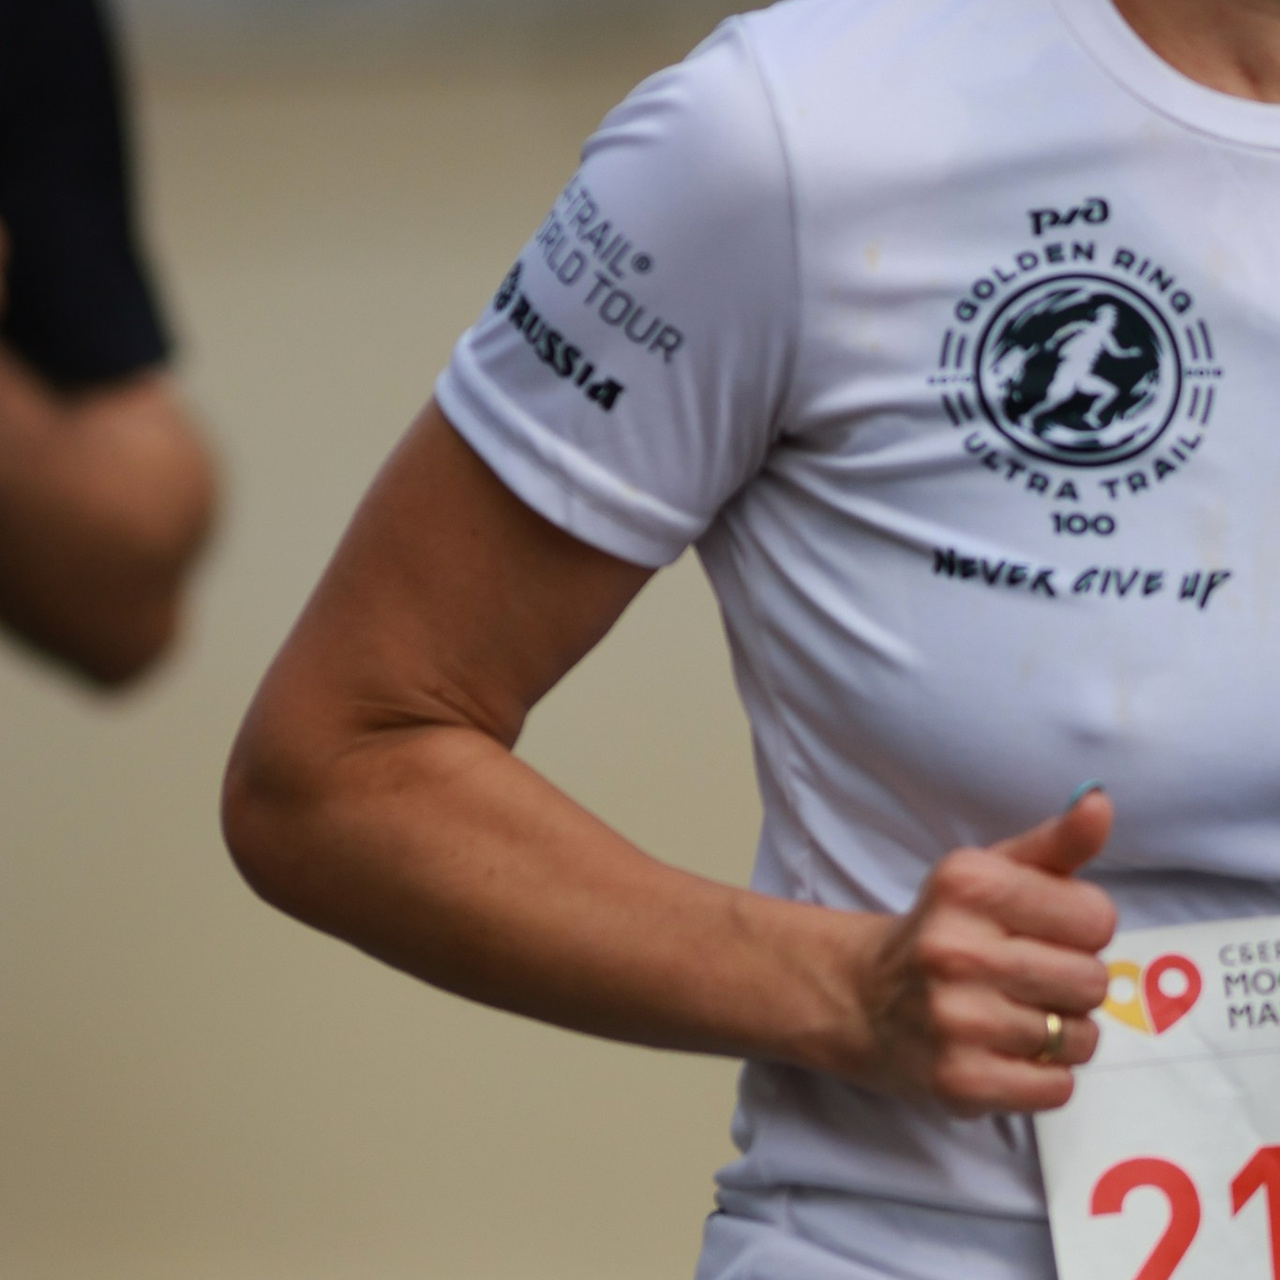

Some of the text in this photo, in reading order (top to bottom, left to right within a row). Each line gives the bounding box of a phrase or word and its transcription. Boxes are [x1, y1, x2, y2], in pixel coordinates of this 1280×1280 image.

[584, 270, 684, 363] TOUR
[955, 242, 1193, 321] GOLDEN RING
[963, 431, 1203, 501] ULTRA TRAIL
[1051, 513, 1116, 537] 100
[931, 548, 1232, 609] NEVER GIVE UP
